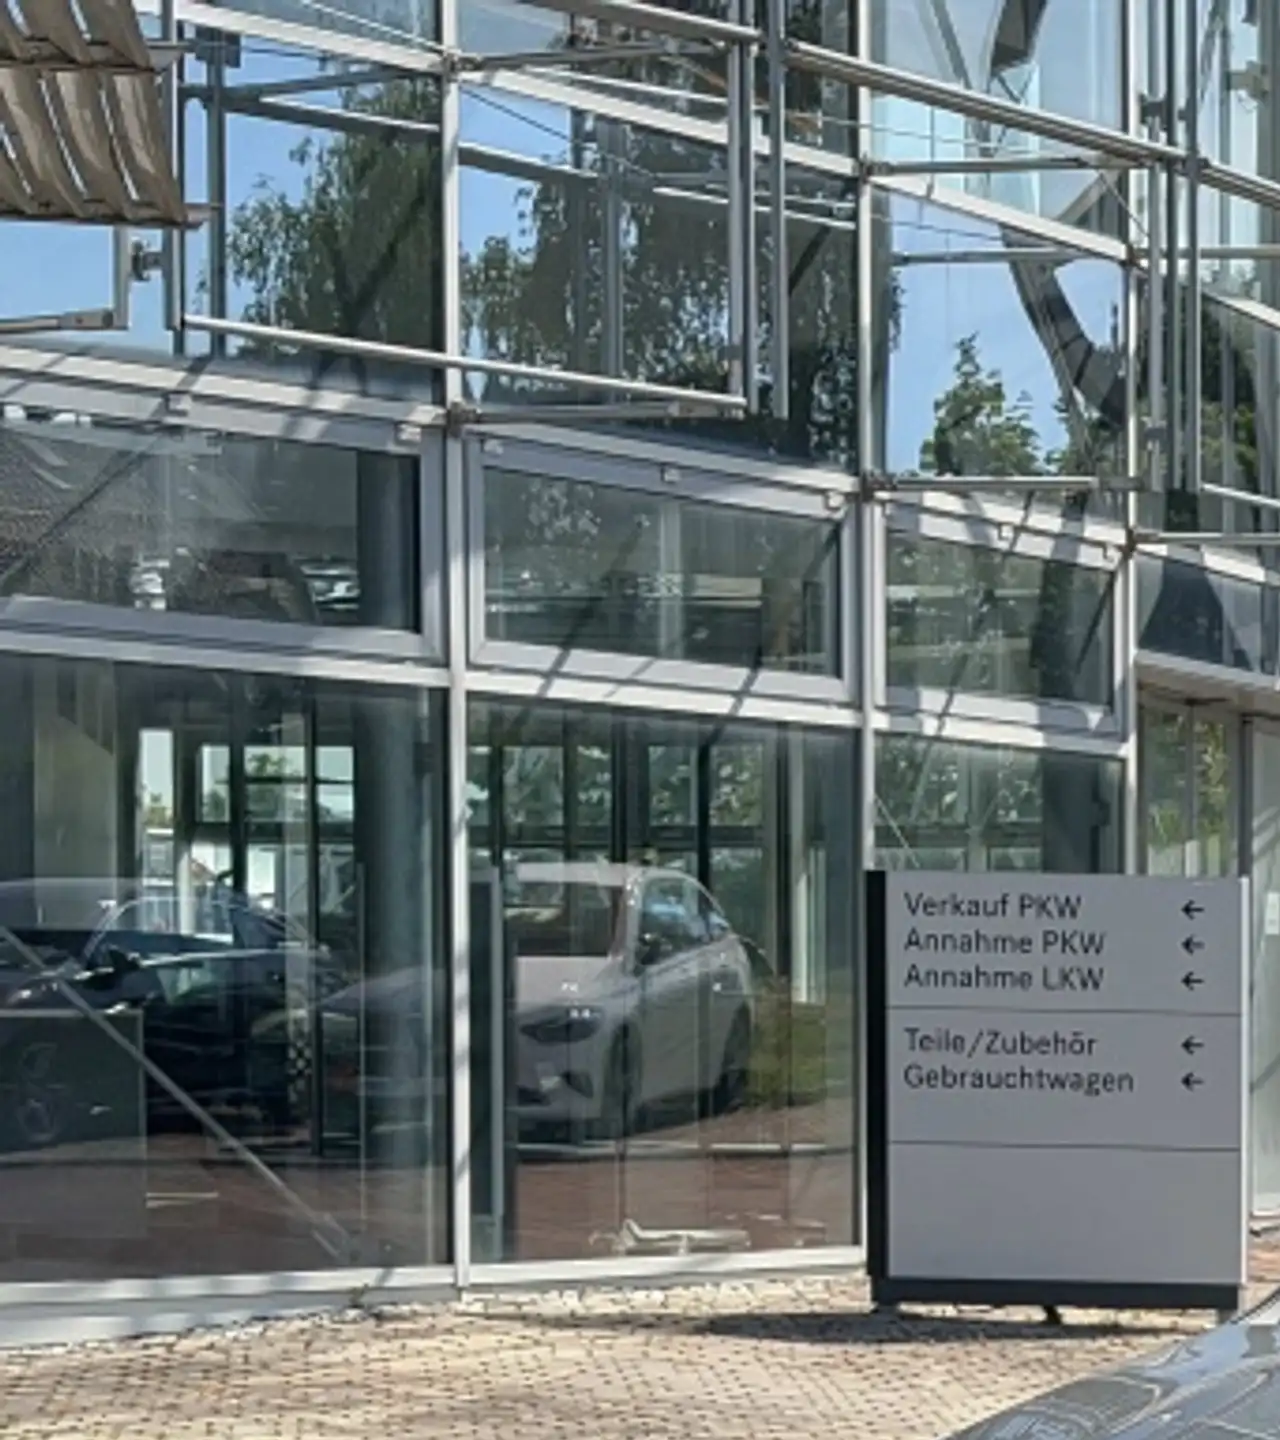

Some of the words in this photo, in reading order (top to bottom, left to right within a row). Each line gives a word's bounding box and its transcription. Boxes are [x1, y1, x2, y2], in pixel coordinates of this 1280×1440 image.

[903, 892, 1009, 918] Verkauf
[1018, 893, 1082, 919] PKW
[903, 928, 1034, 954] Annahme
[1041, 930, 1105, 955] PKW
[903, 963, 1034, 989] Annahme
[1041, 966, 1105, 991] LKW
[904, 1027, 1097, 1058] Teile/Zubehör
[903, 1064, 1134, 1098] Gebrauchtwagen
